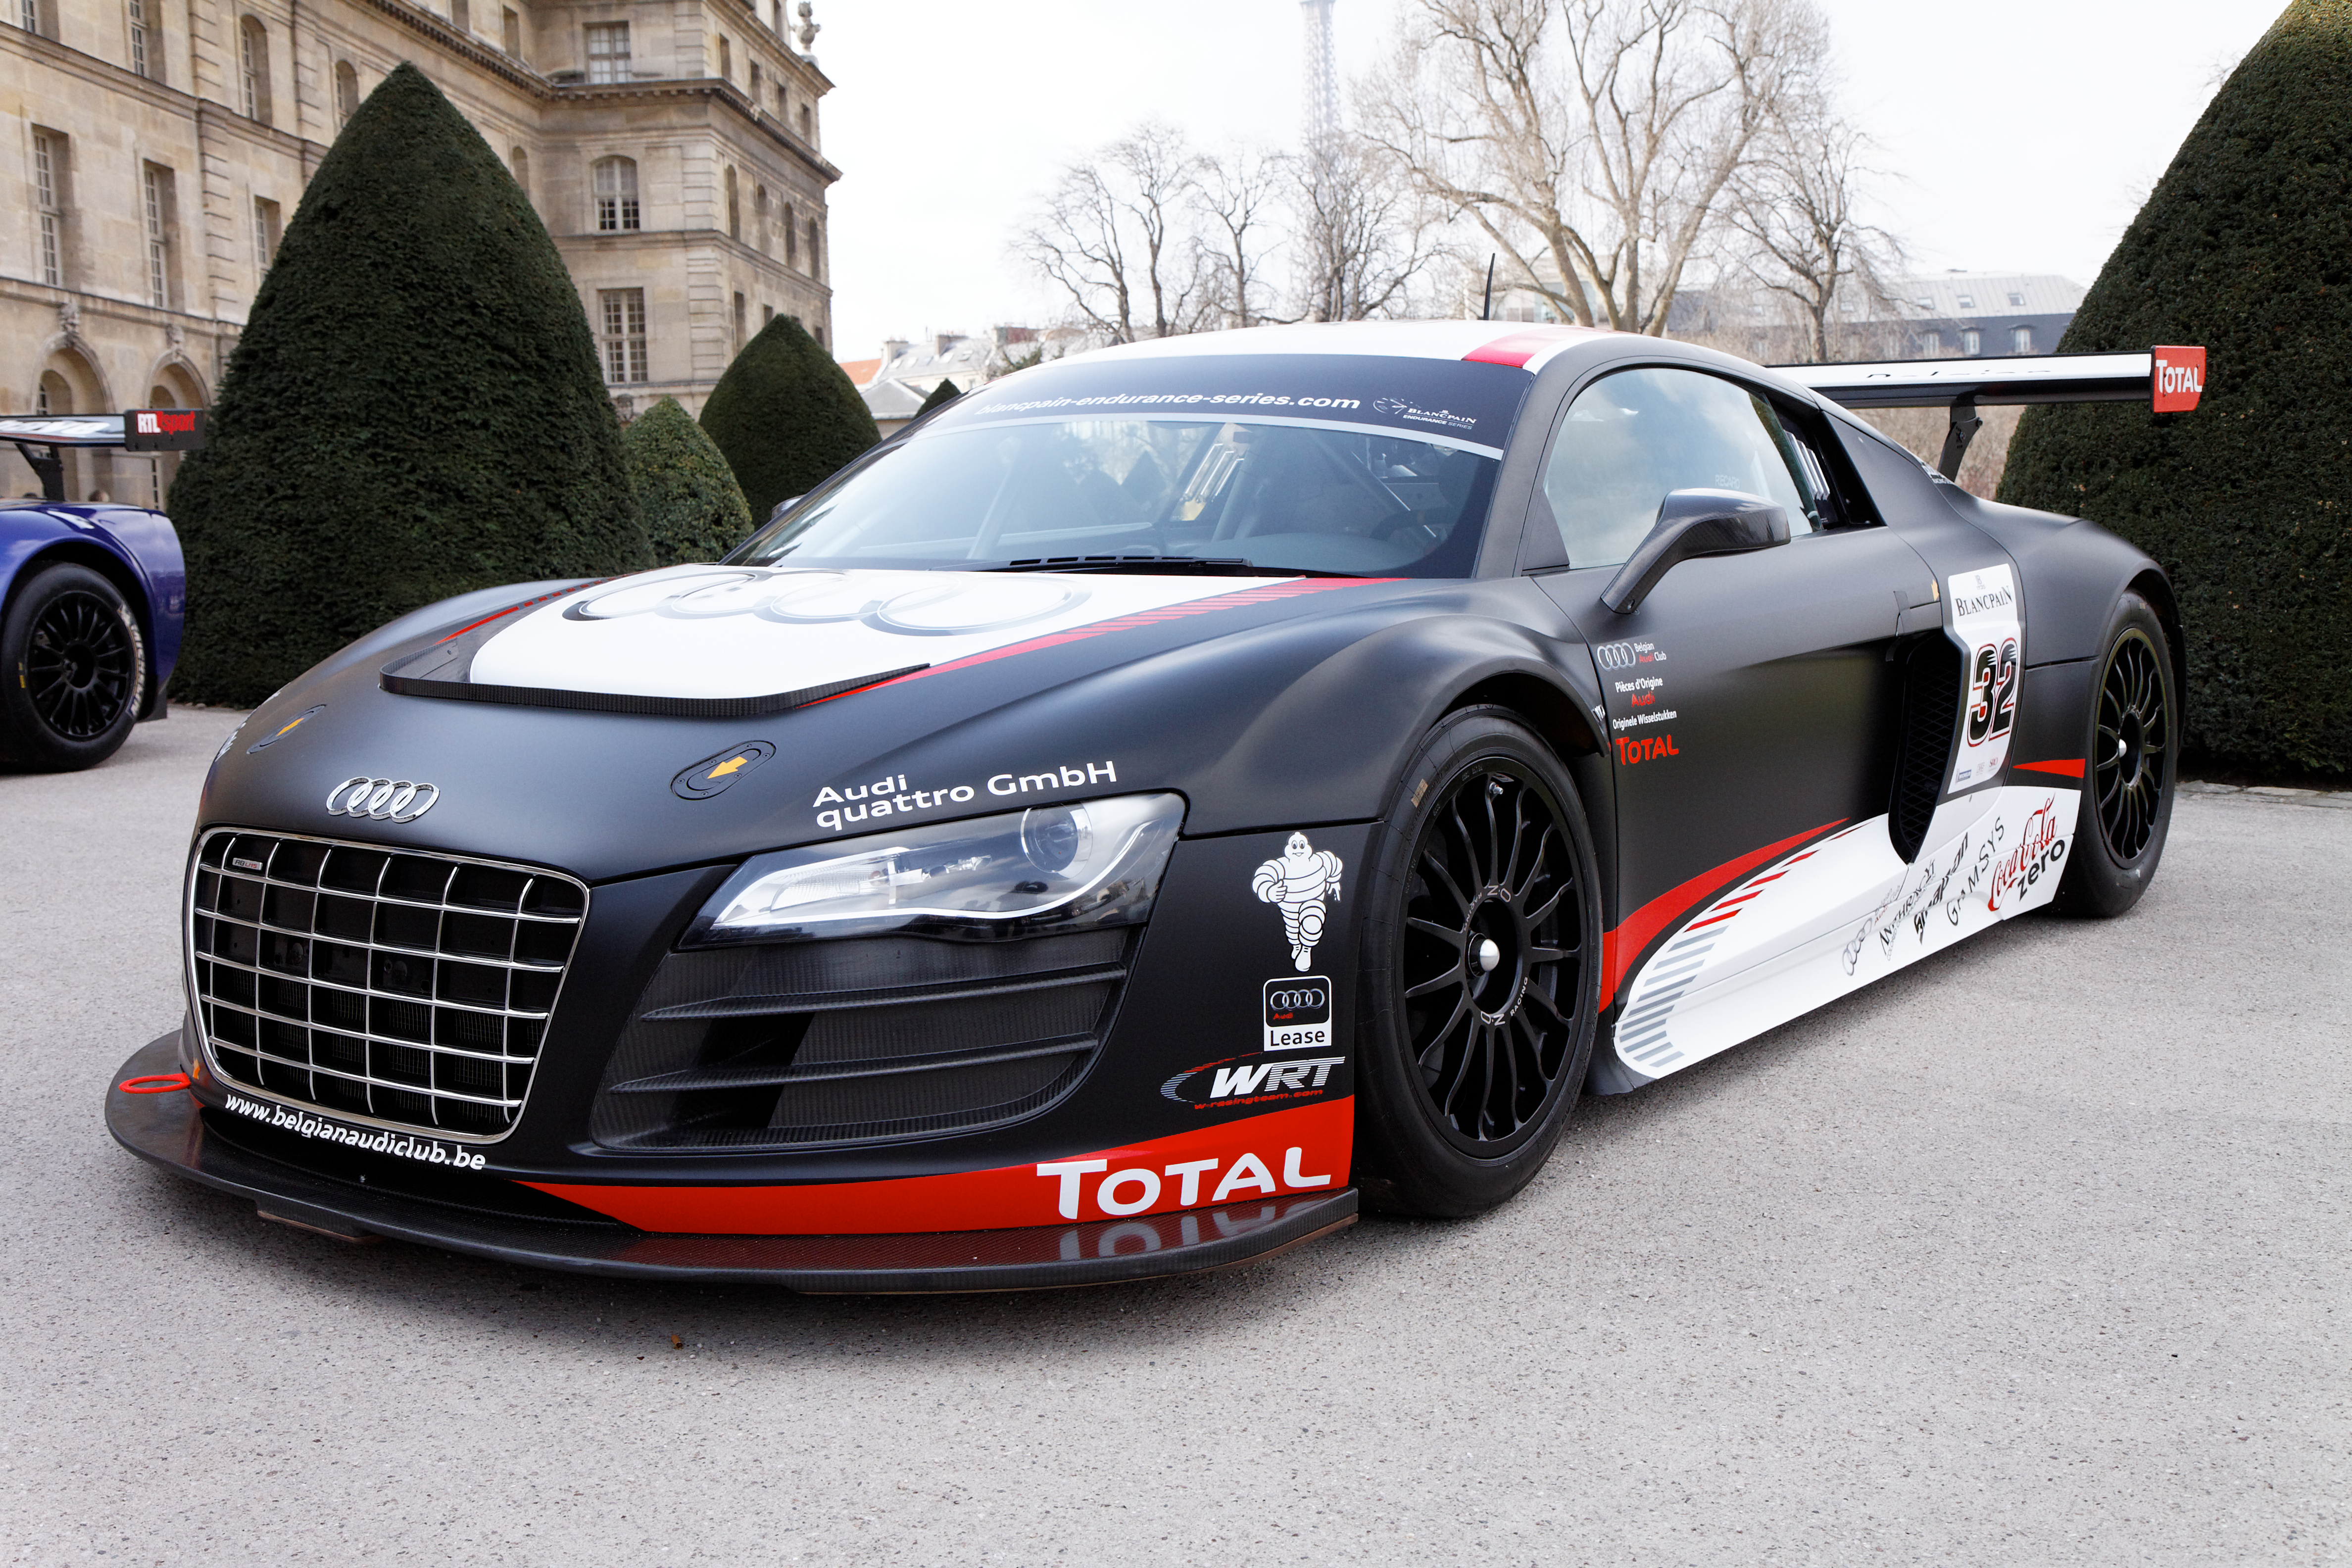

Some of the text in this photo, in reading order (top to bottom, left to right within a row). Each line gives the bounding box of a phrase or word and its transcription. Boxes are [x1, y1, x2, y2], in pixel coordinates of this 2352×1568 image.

[2156, 360, 2202, 393] TOTAL
[975, 392, 1360, 415] blancpain-endurance-series.com
[137, 413, 161, 434] RTL
[1403, 414, 1447, 425] ENDURANCE
[1407, 408, 1476, 424] BLANCPAIN
[1715, 474, 1740, 490] RECARO
[1955, 586, 2012, 617] BLANCPAIN
[1634, 642, 1655, 653] Belgian
[1639, 651, 1666, 663] Audi Club
[1615, 677, 1663, 693] Pièces d'Origine
[1967, 637, 2018, 747] 32
[1632, 691, 1655, 707] Audi
[1613, 709, 1677, 731] Originele Wisselstukken
[1616, 735, 1679, 765] TOTAL
[812, 775, 907, 808] Audi
[816, 761, 1117, 831] quattro GmbH
[2017, 839, 2065, 902] zero
[1510, 977, 1528, 1016] RACING
[1271, 1030, 1325, 1046] Lease
[1210, 1056, 1345, 1098] WRT
[1194, 1089, 1323, 1110] w-racingteam.com
[226, 1094, 486, 1170] www.belgianaudiclub.be
[1037, 1147, 1331, 1219] TOTAL
